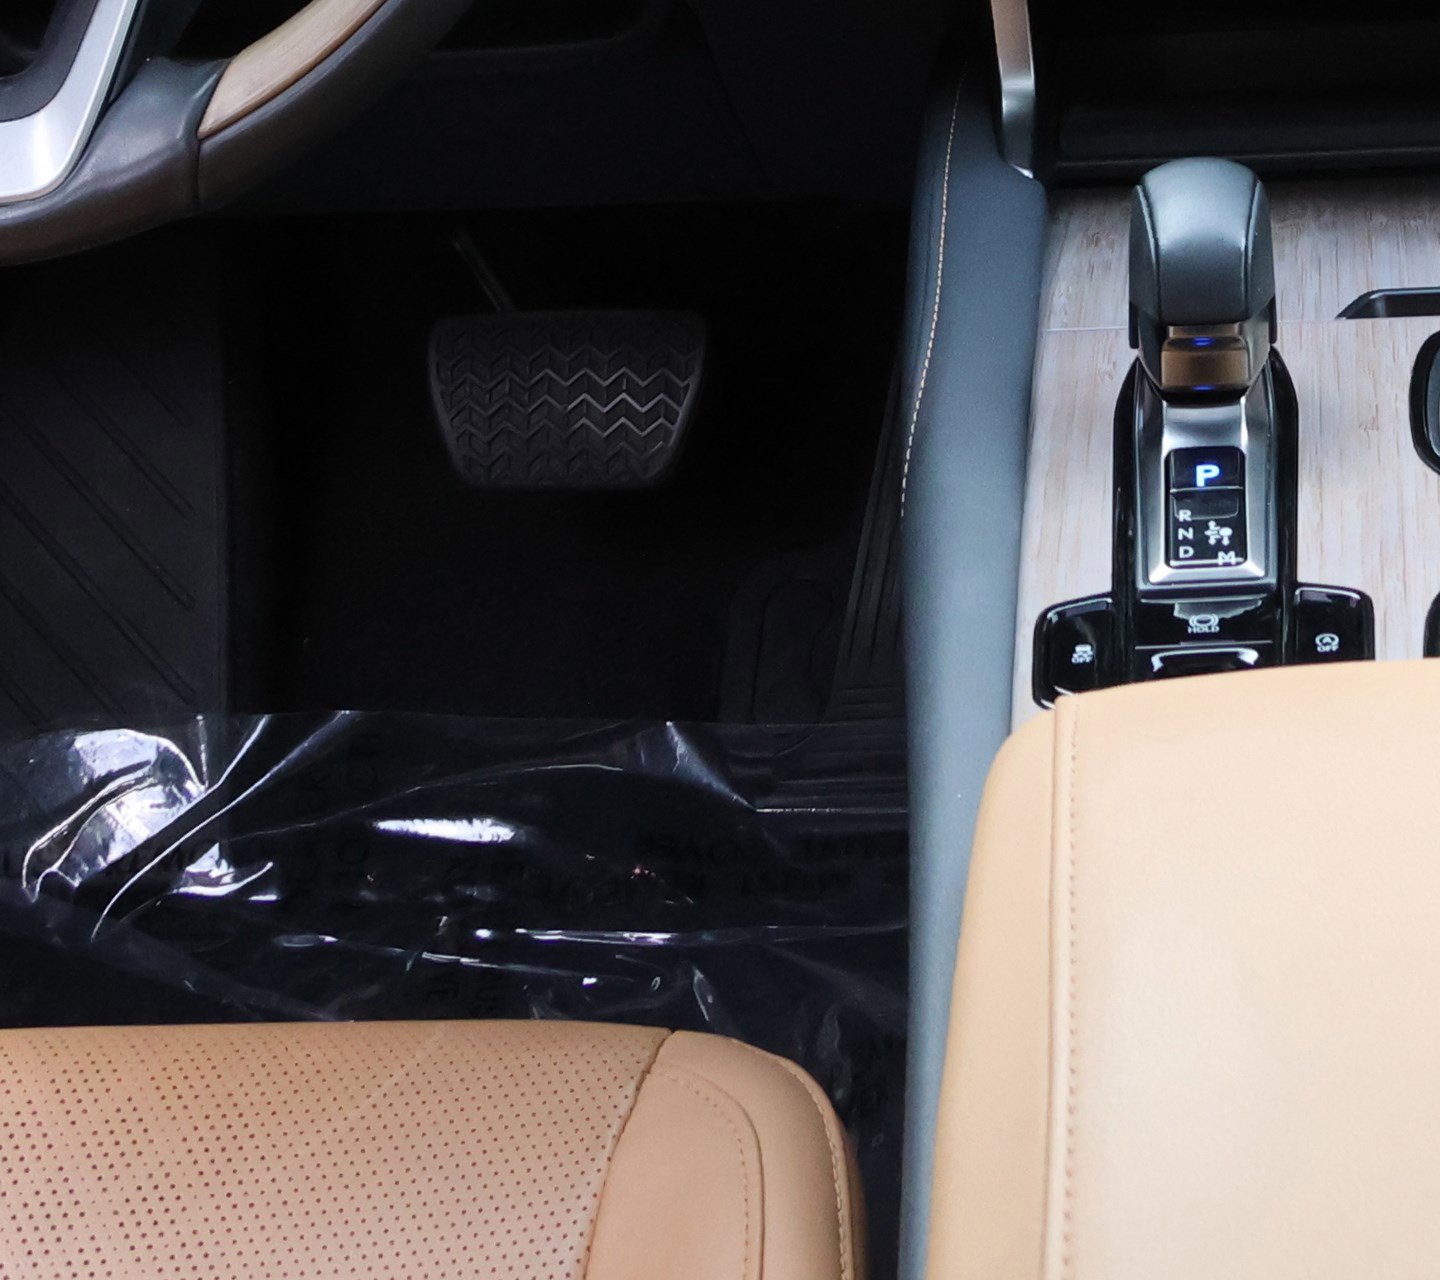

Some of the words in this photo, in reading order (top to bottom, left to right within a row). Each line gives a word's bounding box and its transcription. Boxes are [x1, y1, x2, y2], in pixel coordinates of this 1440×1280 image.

[1195, 464, 1220, 487] P
[1178, 509, 1191, 522] R
[1178, 528, 1193, 540] N
[1179, 547, 1194, 558] D
[1217, 552, 1236, 565] M
[1188, 625, 1219, 634] HOLD
[1317, 643, 1339, 652] OFF
